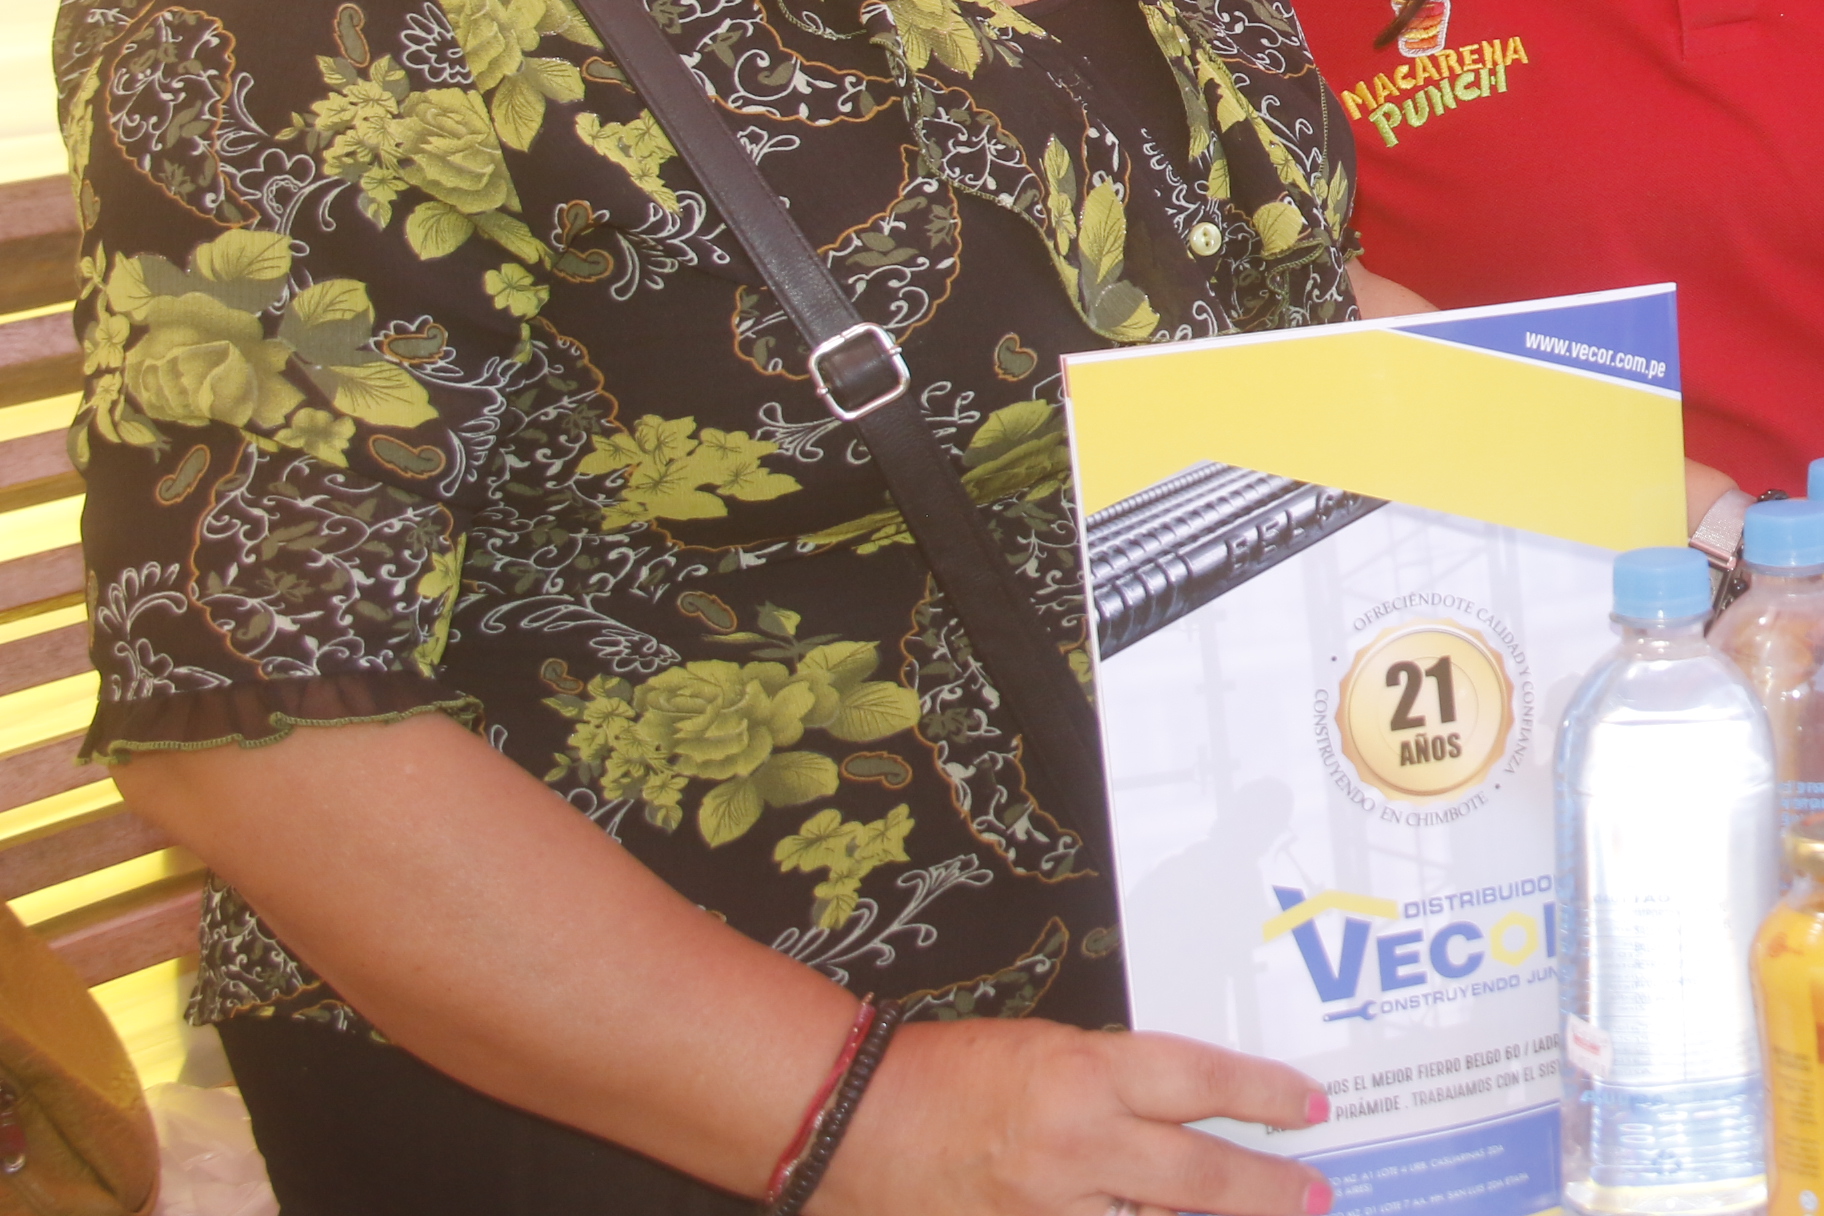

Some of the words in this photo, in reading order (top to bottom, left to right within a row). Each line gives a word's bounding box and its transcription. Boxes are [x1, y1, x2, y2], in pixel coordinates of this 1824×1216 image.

[1340, 36, 1529, 121] MACARENA
[1368, 64, 1508, 148] PUNCH
[1525, 331, 1667, 379] www.vecor.com.pe
[1353, 591, 1476, 633] OFRECIÉNDOTE
[1476, 606, 1526, 665] CALIDAD
[1503, 679, 1536, 776] CONFIANZA
[1384, 654, 1458, 732] 21
[1312, 687, 1377, 814] CONSTRUYENDO
[1379, 802, 1404, 825] EN
[1404, 789, 1489, 828] CHIMBOTE
[1399, 731, 1463, 767] AÑOS
[1403, 873, 1556, 920] DISTRIBUIDO
[1335, 1093, 1401, 1122] PIRÁMIDE
[1411, 1076, 1492, 1107] TRABAJAMOS
[1496, 1070, 1520, 1089] CON
[1523, 1066, 1535, 1082] EL
[1353, 1074, 1367, 1092] EL
[1371, 1065, 1414, 1088] MEJOR
[1417, 1056, 1462, 1080] FIERRO
[1465, 1047, 1501, 1070] BELGO
[1505, 1043, 1521, 1061] 60
